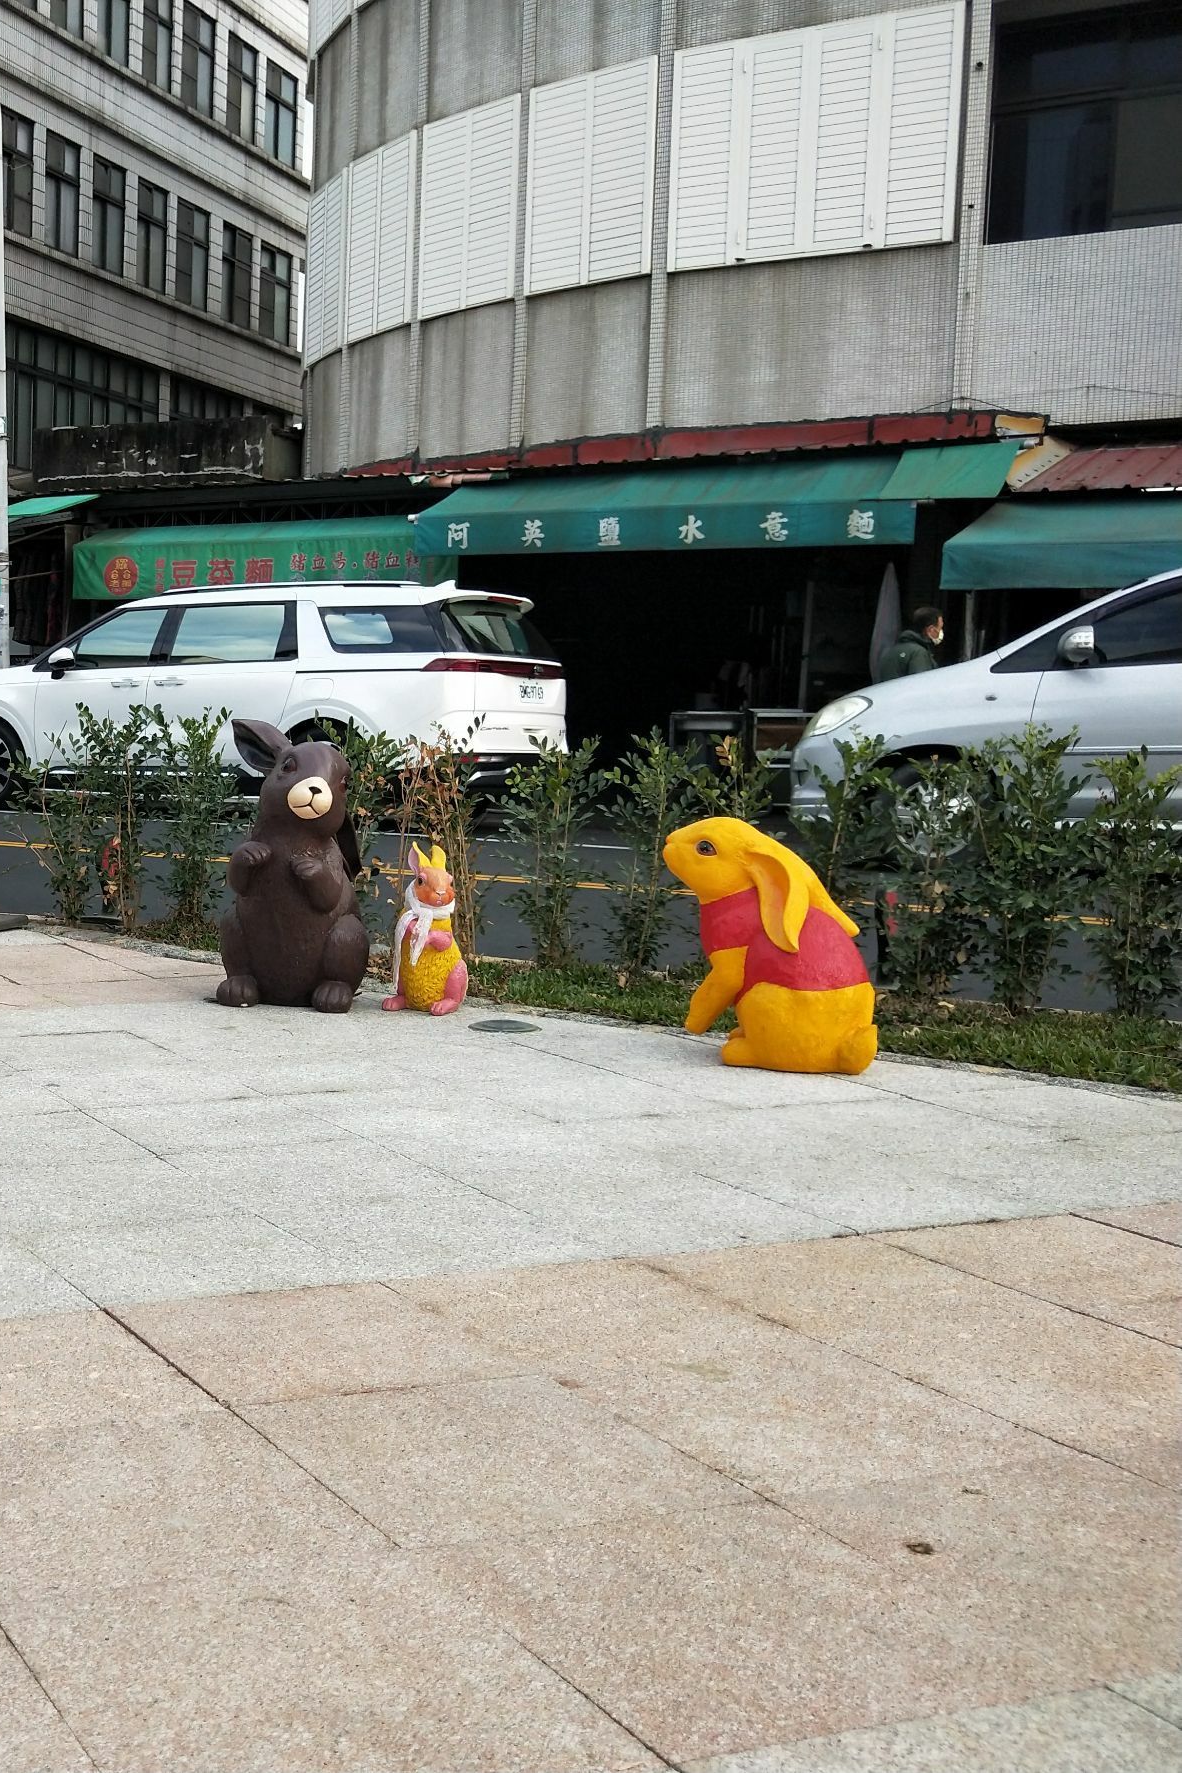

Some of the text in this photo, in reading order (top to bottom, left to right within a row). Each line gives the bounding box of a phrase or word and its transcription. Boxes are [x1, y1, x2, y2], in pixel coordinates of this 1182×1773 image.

[447, 509, 875, 549] 阿英鹽水意麵
